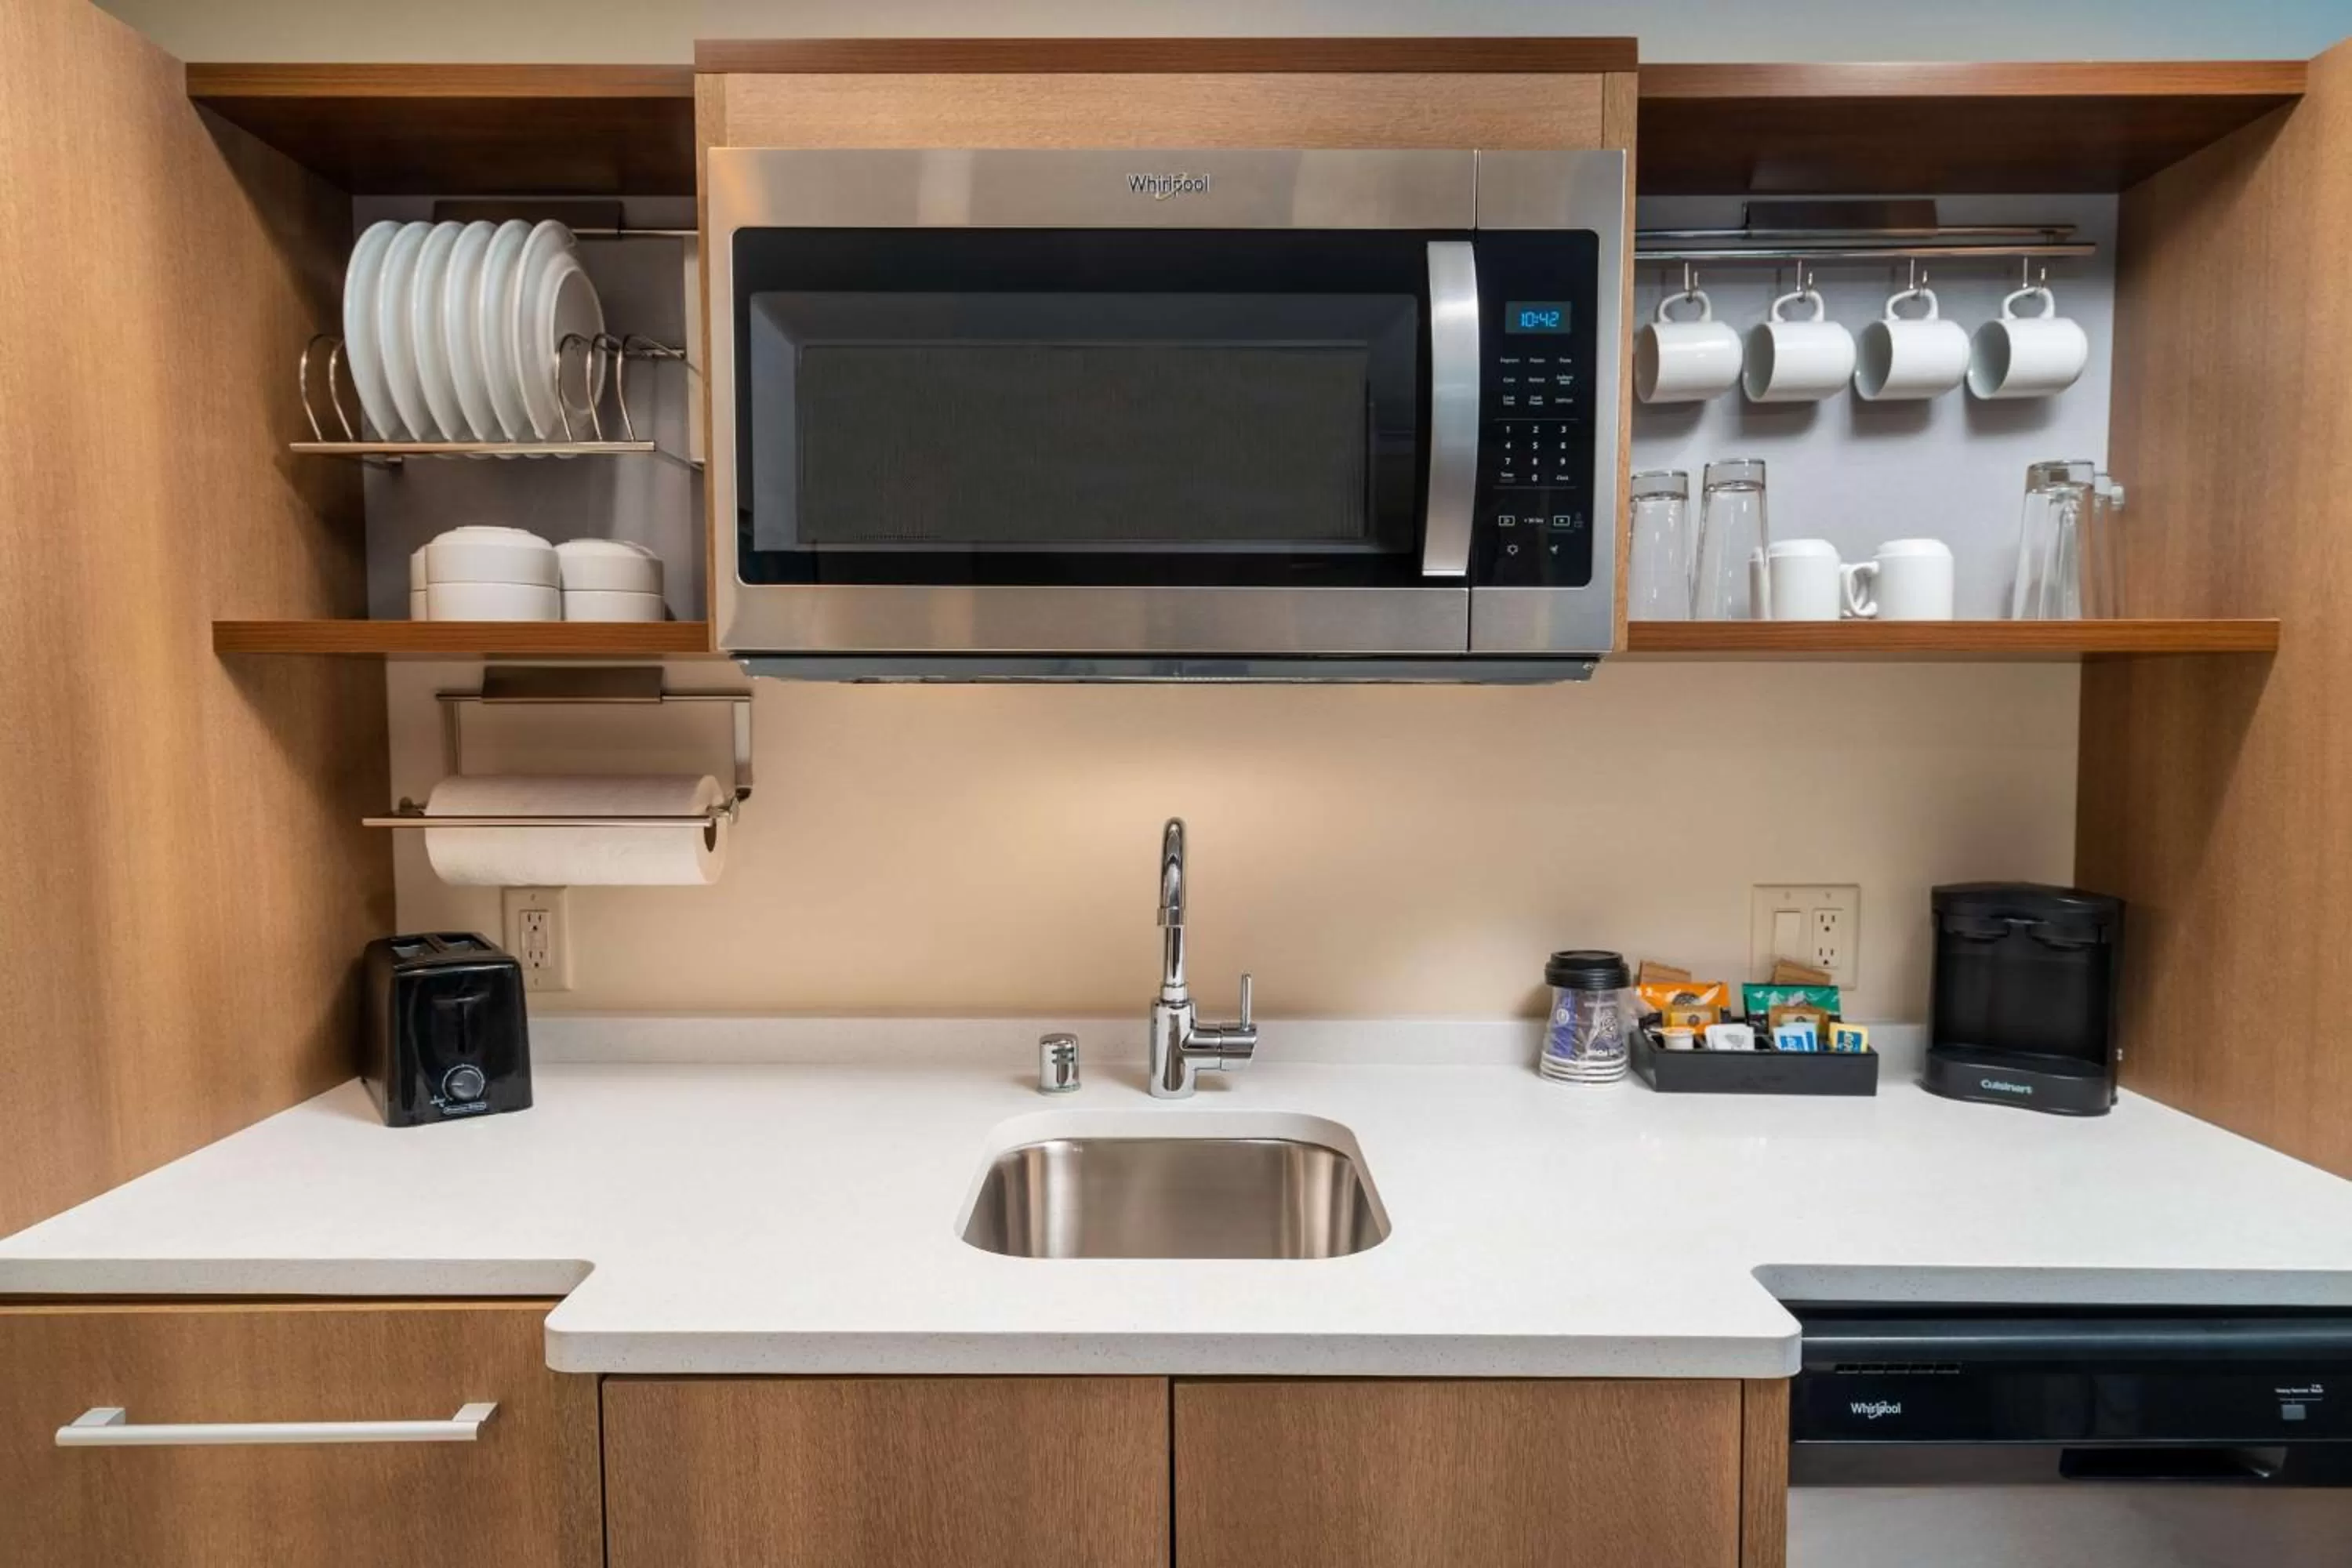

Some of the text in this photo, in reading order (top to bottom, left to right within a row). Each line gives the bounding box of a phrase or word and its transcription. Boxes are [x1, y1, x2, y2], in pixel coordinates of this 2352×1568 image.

[1127, 174, 1210, 199] Whirlpool
[1521, 311, 1559, 327] 10:42
[1980, 1079, 2034, 1095] Cuisinart
[1850, 1401, 1901, 1418] Whirlpool
